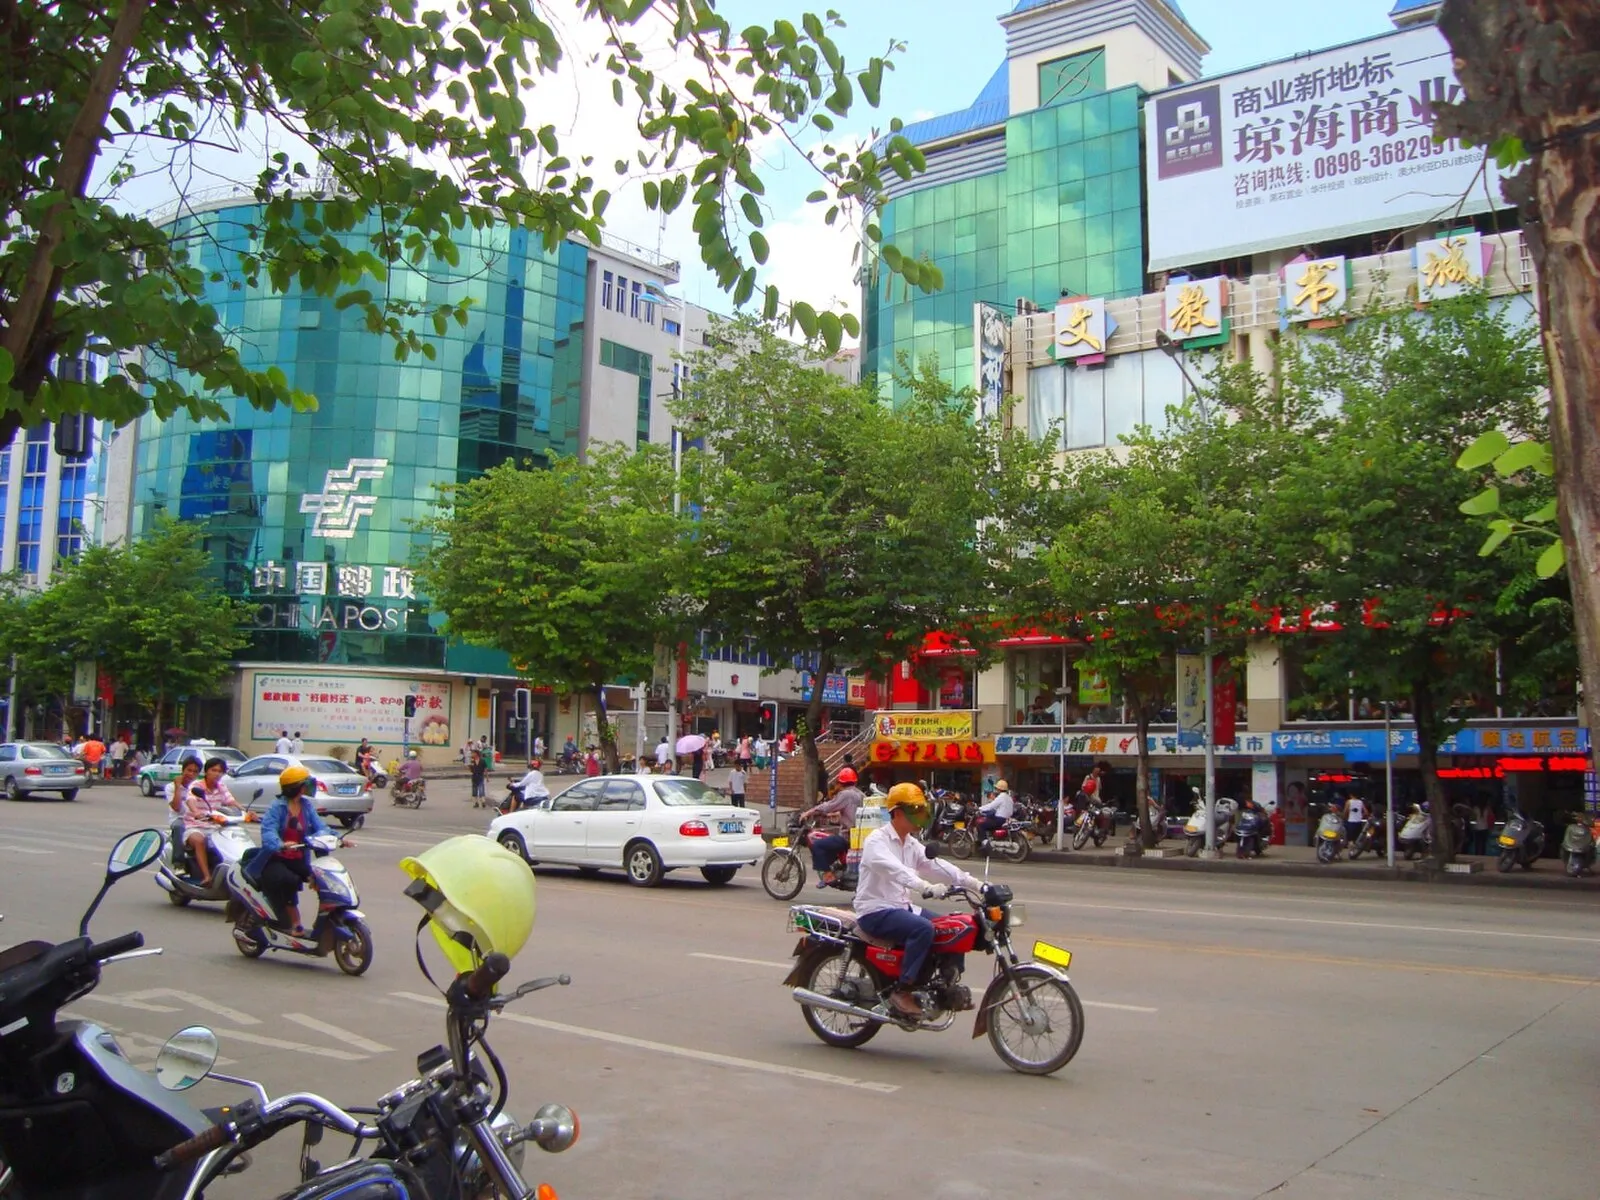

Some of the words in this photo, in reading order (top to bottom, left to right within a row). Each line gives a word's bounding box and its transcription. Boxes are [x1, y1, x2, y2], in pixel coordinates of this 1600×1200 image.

[1232, 53, 1394, 117] 商业新地标
[254, 560, 416, 600] 中国邮政
[344, 605, 415, 632] POST
